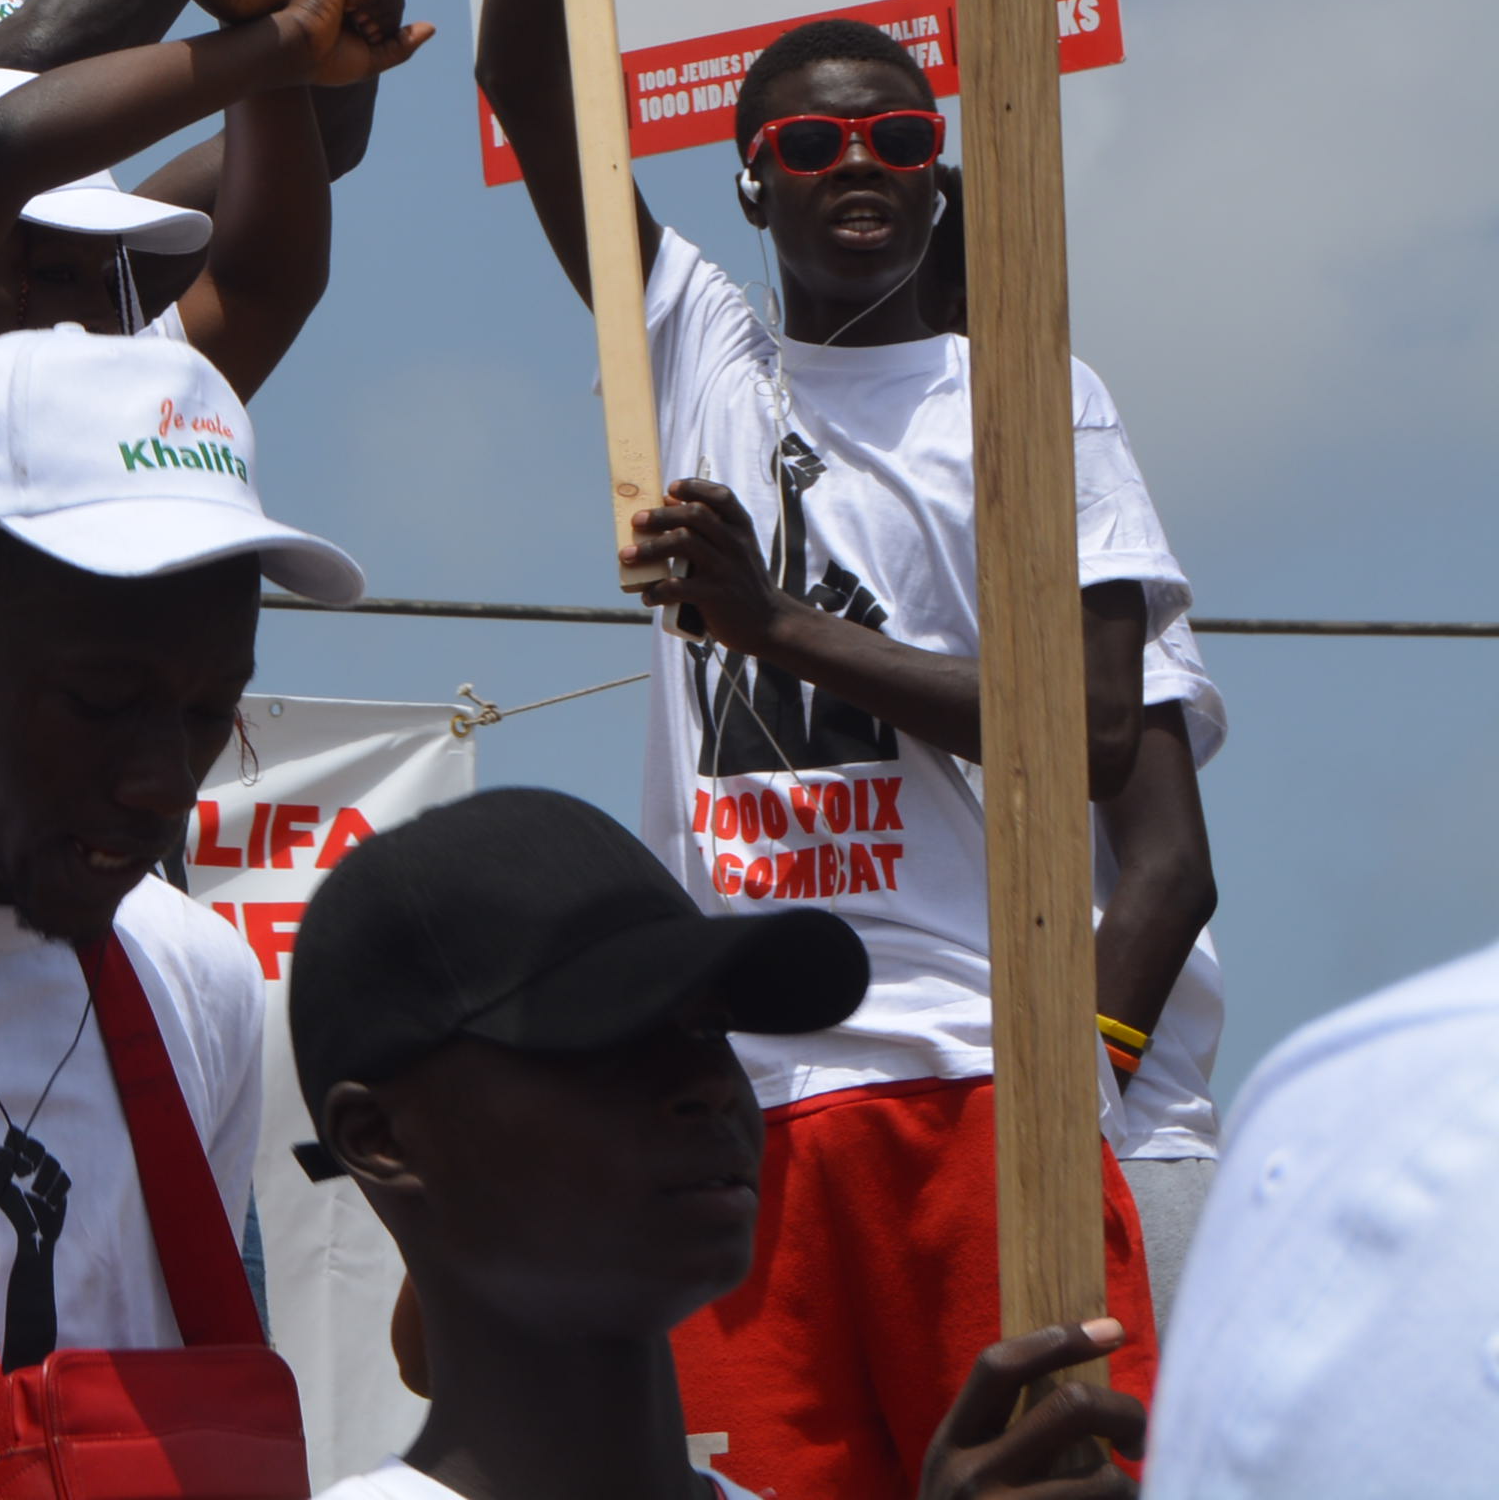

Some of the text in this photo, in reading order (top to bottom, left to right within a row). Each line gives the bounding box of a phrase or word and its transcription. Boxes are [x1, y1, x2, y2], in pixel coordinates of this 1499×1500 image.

[639, 68, 677, 92] 1000
[679, 55, 741, 83] JEUNES
[640, 92, 690, 122] 1000
[159, 398, 185, 436] Je
[119, 437, 248, 485] Khalifa
[188, 800, 377, 869] LIFA
[692, 777, 904, 844] 1000 VOIX
[713, 843, 903, 900] COMBAT
